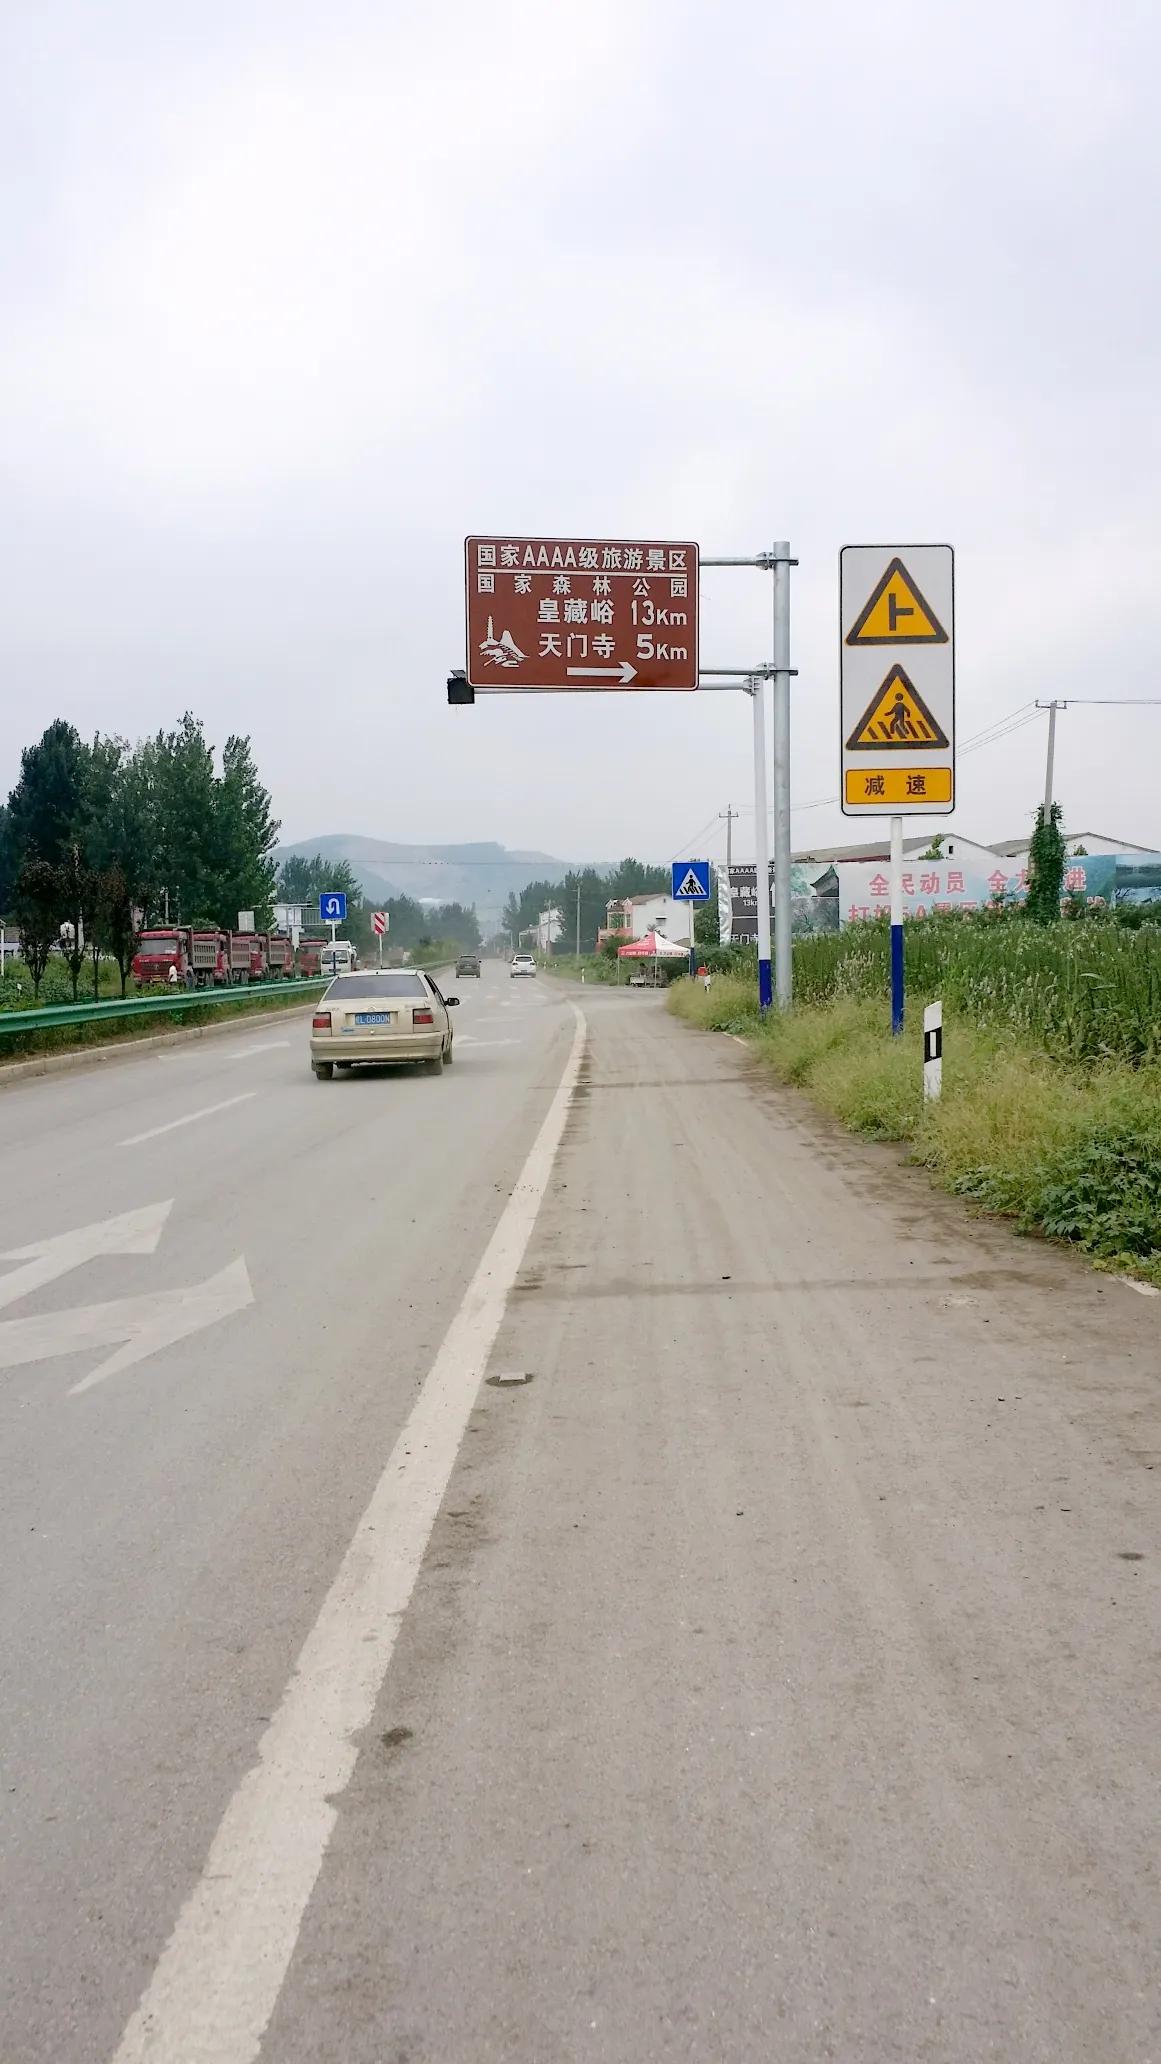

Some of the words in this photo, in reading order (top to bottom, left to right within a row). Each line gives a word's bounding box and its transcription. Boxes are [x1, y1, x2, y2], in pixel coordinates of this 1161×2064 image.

[477, 544, 688, 571] 国家AAAA级旅游景区
[477, 574, 688, 598] 国家森林公园
[537, 598, 615, 625] 皇藏峪
[538, 633, 616, 659] 天门寺
[636, 633, 688, 660] 5Km
[864, 774, 926, 796] 减速
[987, 867, 1087, 895] 全力进
